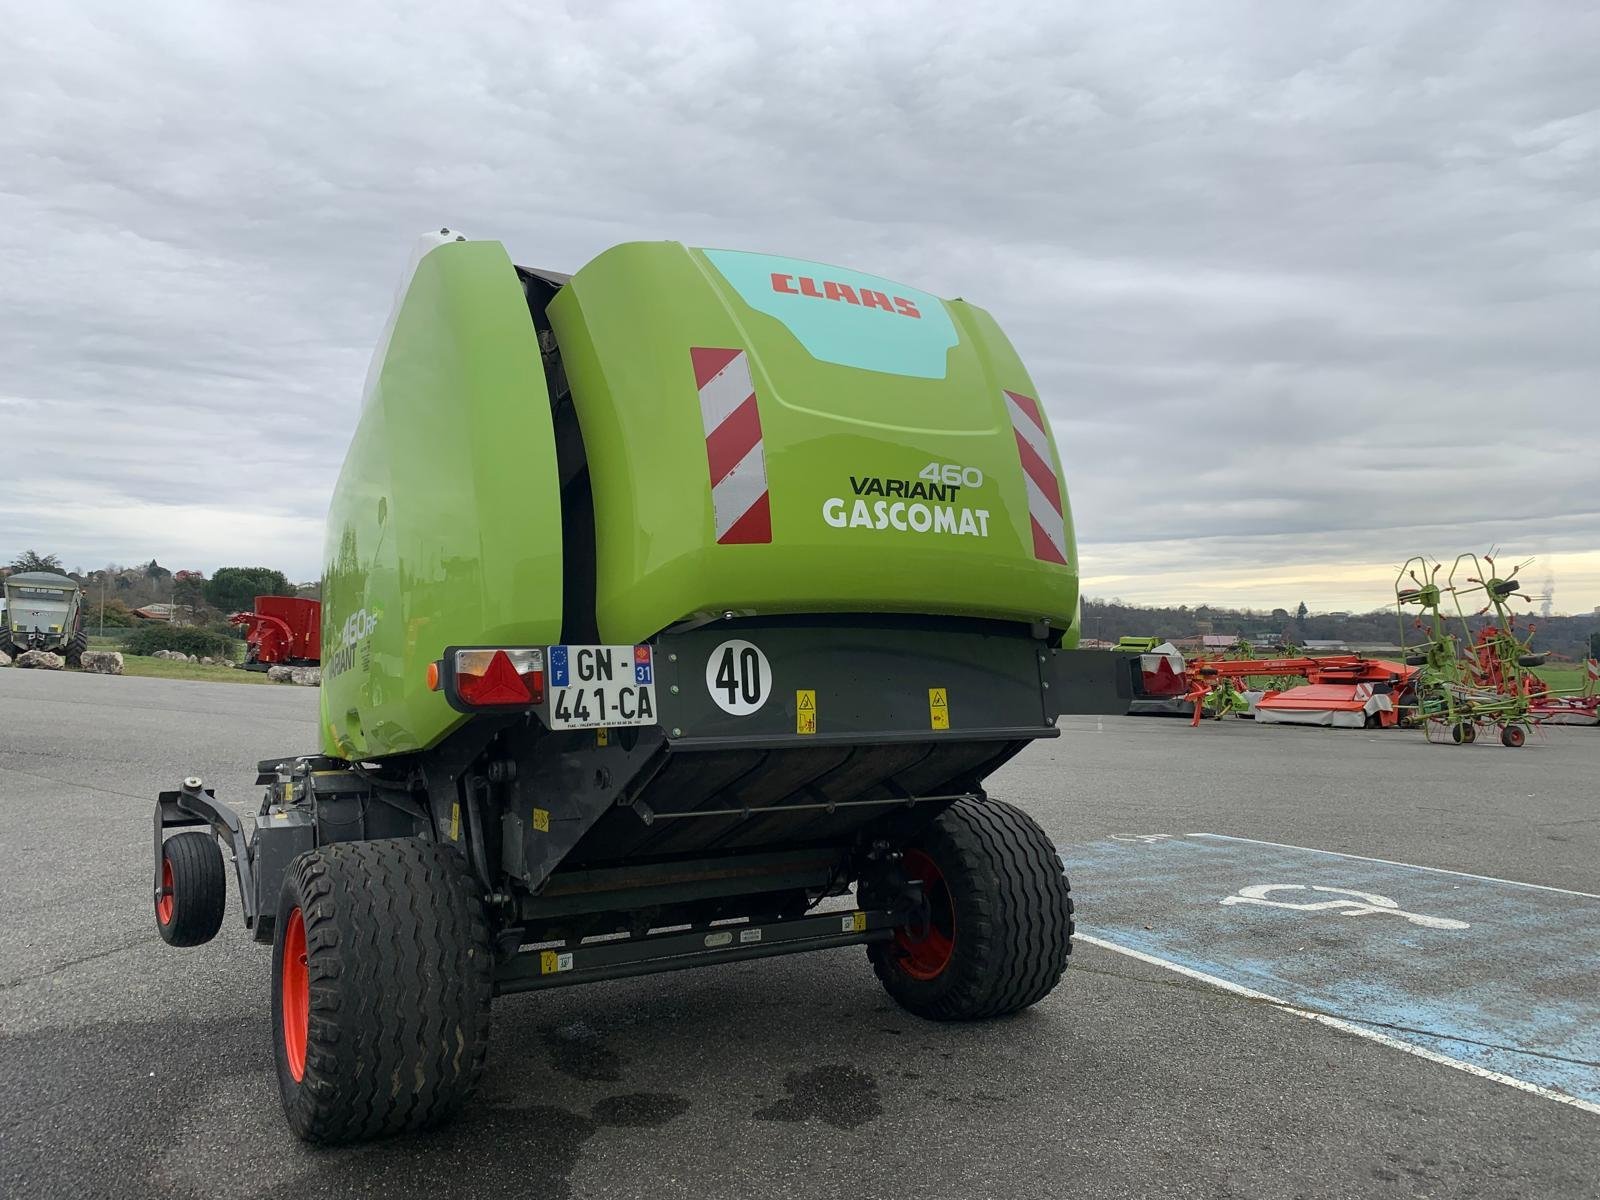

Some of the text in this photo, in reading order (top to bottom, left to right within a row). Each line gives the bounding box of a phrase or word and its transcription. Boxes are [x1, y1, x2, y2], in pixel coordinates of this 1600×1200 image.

[771, 272, 921, 319] CLAAS
[849, 476, 961, 503] VARIANT
[918, 462, 984, 488] 460
[822, 497, 990, 537] GASCOMAT
[556, 670, 563, 681] F
[637, 666, 651, 681] 31
[716, 647, 761, 705] 40
[554, 686, 653, 723] 441-CA
